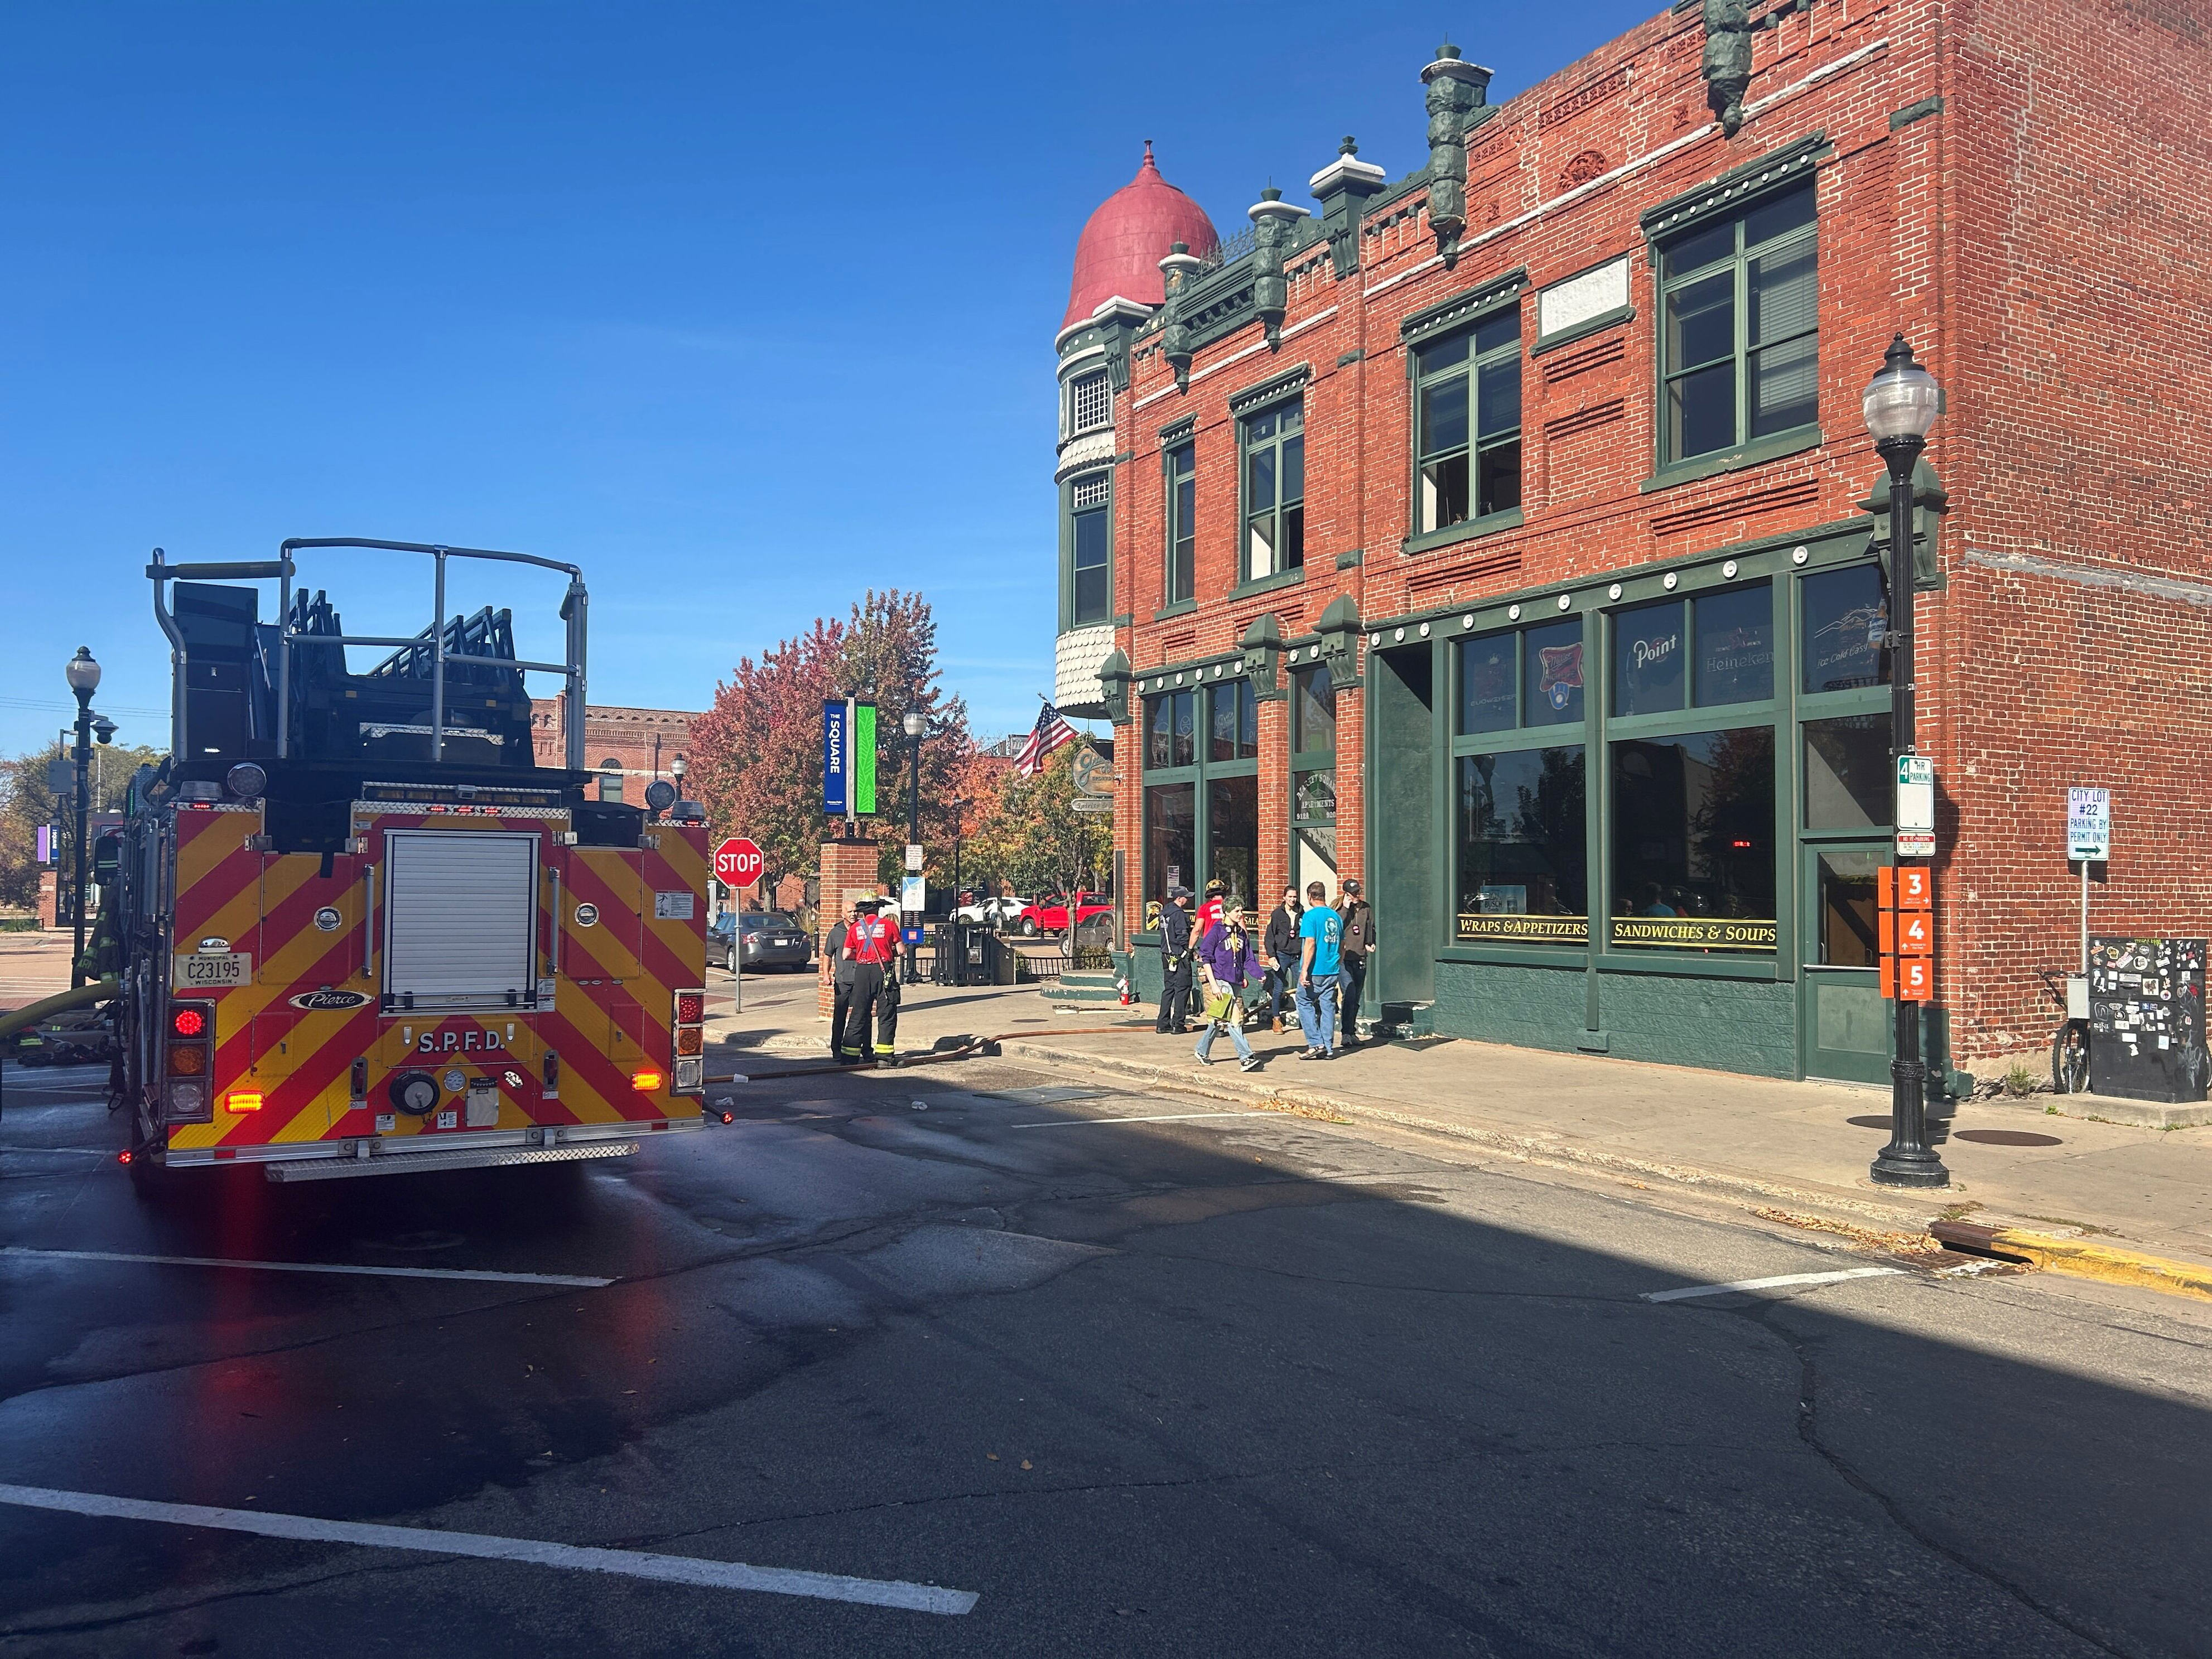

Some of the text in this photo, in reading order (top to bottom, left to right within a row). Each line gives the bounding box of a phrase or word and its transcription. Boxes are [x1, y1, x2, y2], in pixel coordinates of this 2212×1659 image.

[1633, 634, 1676, 668] Point
[1830, 649, 1848, 663] Cold
[1706, 651, 1774, 672] Heineken
[828, 720, 840, 774] SQUARE
[1900, 761, 1925, 779] 4 HR
[1910, 773, 1931, 782] PARKING
[2071, 790, 2107, 802] CITY LOT
[2079, 804, 2098, 816] #22
[2070, 818, 2107, 830] PARKING BY
[2070, 831, 2107, 842] PERMIT ONLY
[717, 853, 760, 872] STOP
[1909, 874, 1922, 895] 3
[1484, 900, 1502, 908] BUSCH
[1461, 919, 1501, 932] WRAPS
[1615, 923, 1776, 942] SANDWICHES & SOUPS
[1909, 919, 1924, 940] 4
[188, 962, 239, 978] C23195
[1910, 965, 1923, 986] 5
[308, 993, 355, 1007] Pierce
[419, 1031, 505, 1053] S.P.F.D.
